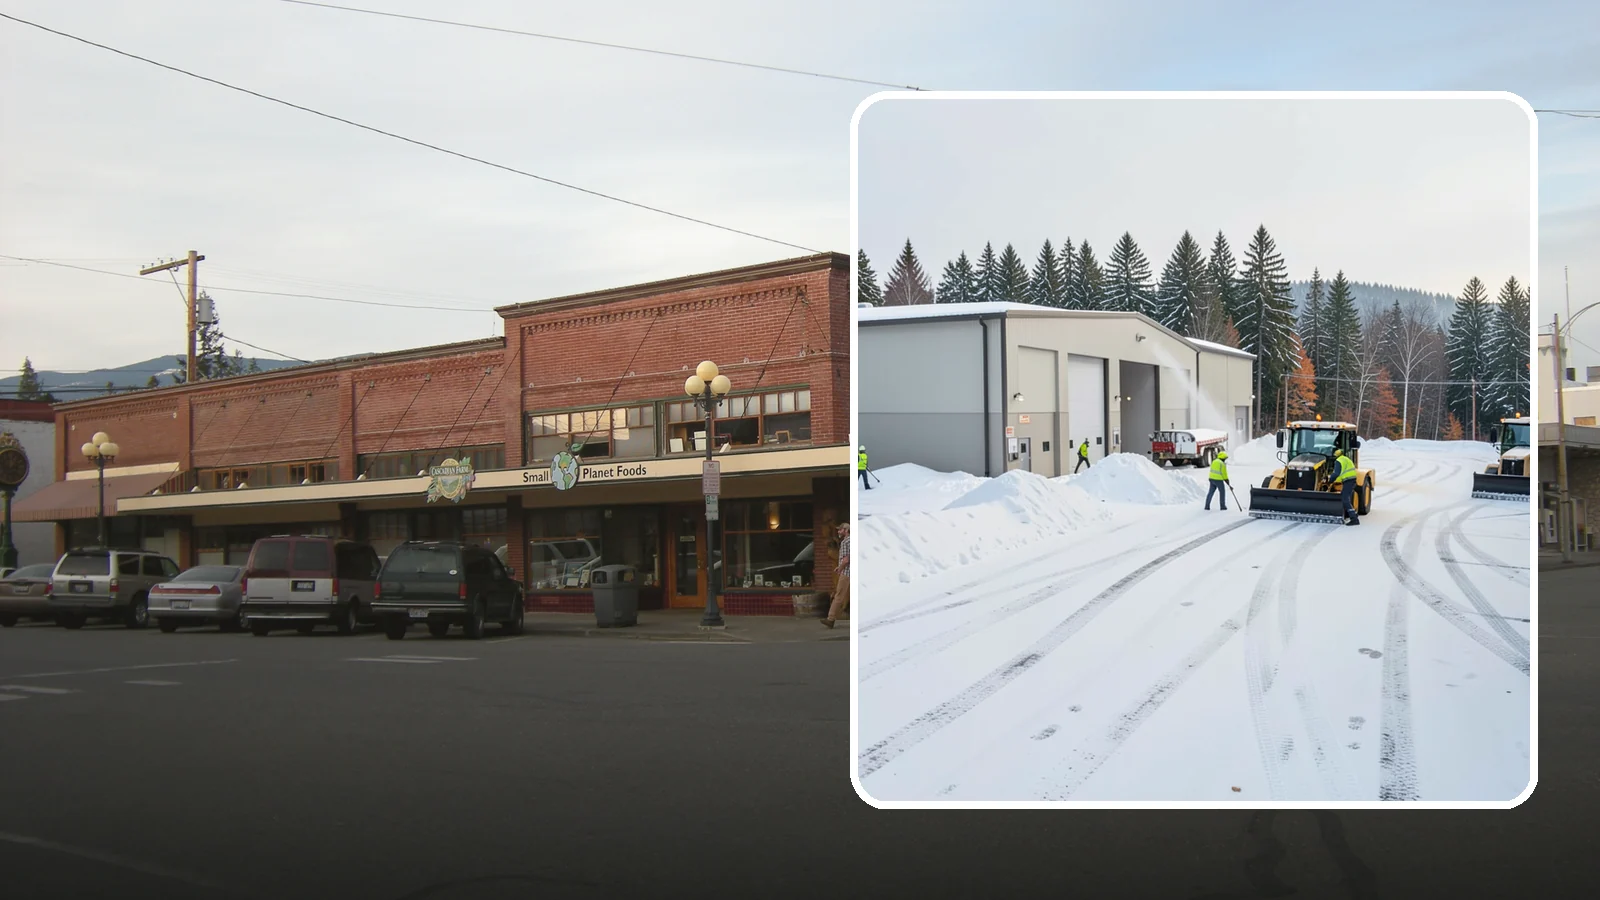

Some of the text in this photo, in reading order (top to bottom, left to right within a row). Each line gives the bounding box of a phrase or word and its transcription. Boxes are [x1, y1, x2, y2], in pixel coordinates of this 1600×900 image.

[523, 465, 647, 482] Small Planet Foods
